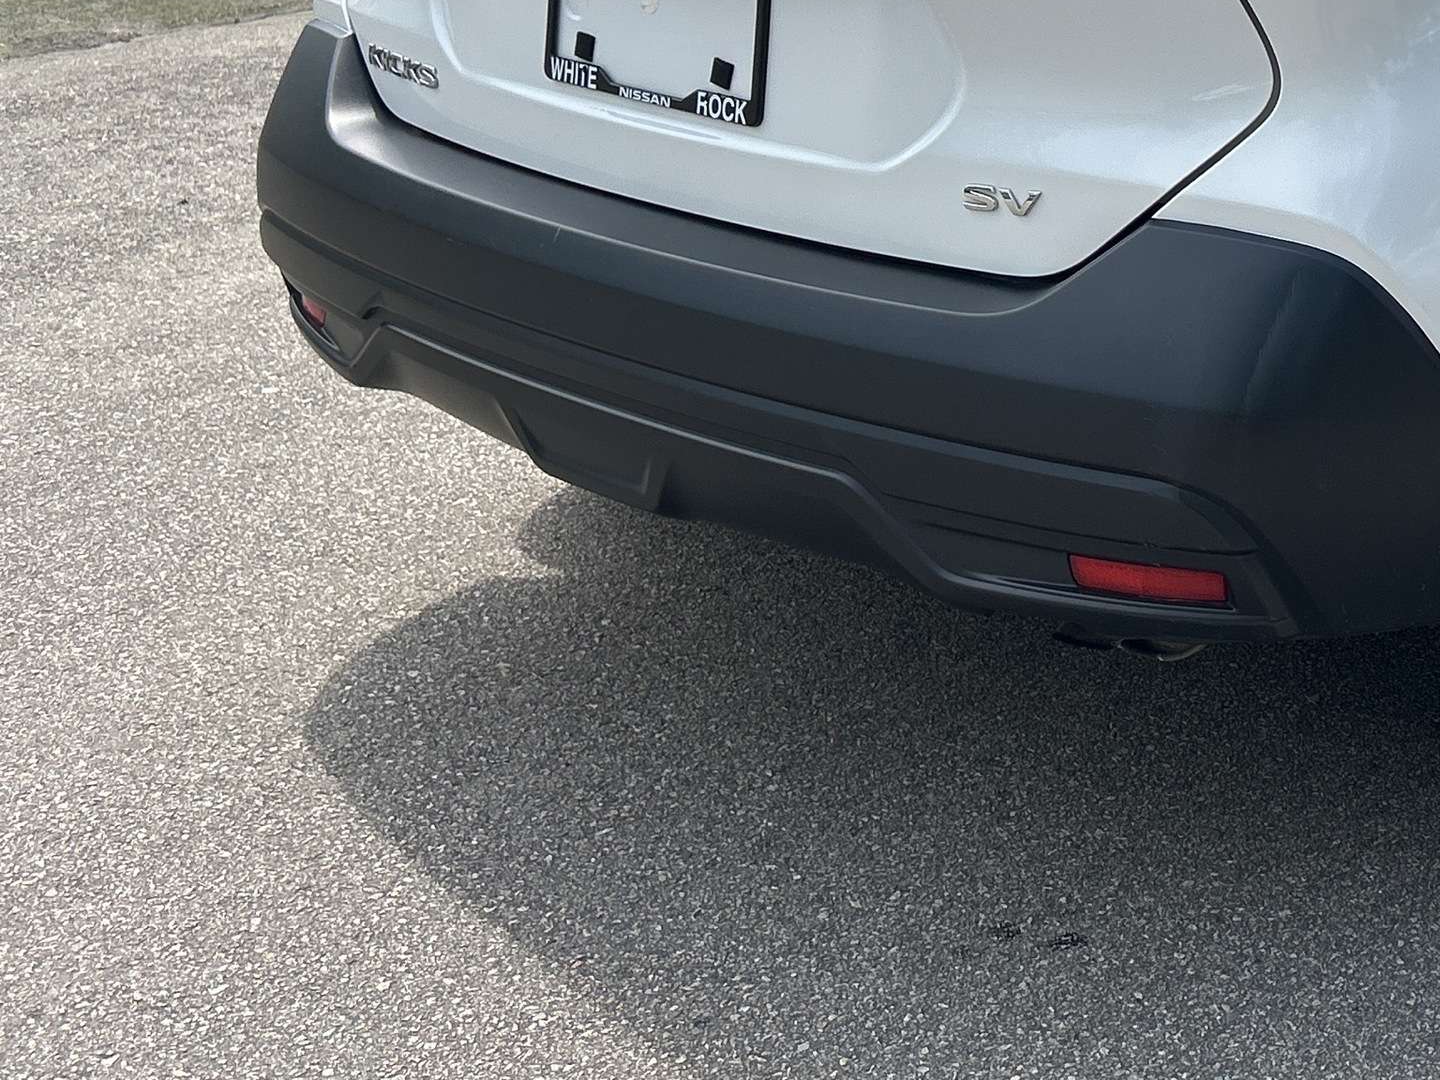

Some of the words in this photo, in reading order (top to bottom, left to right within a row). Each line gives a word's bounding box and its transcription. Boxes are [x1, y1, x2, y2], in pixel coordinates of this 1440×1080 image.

[368, 42, 439, 89] KICKS
[550, 56, 598, 89] WHITE
[618, 87, 671, 108] NISSAN
[696, 91, 748, 126] ROCK
[962, 183, 1043, 217] SV
